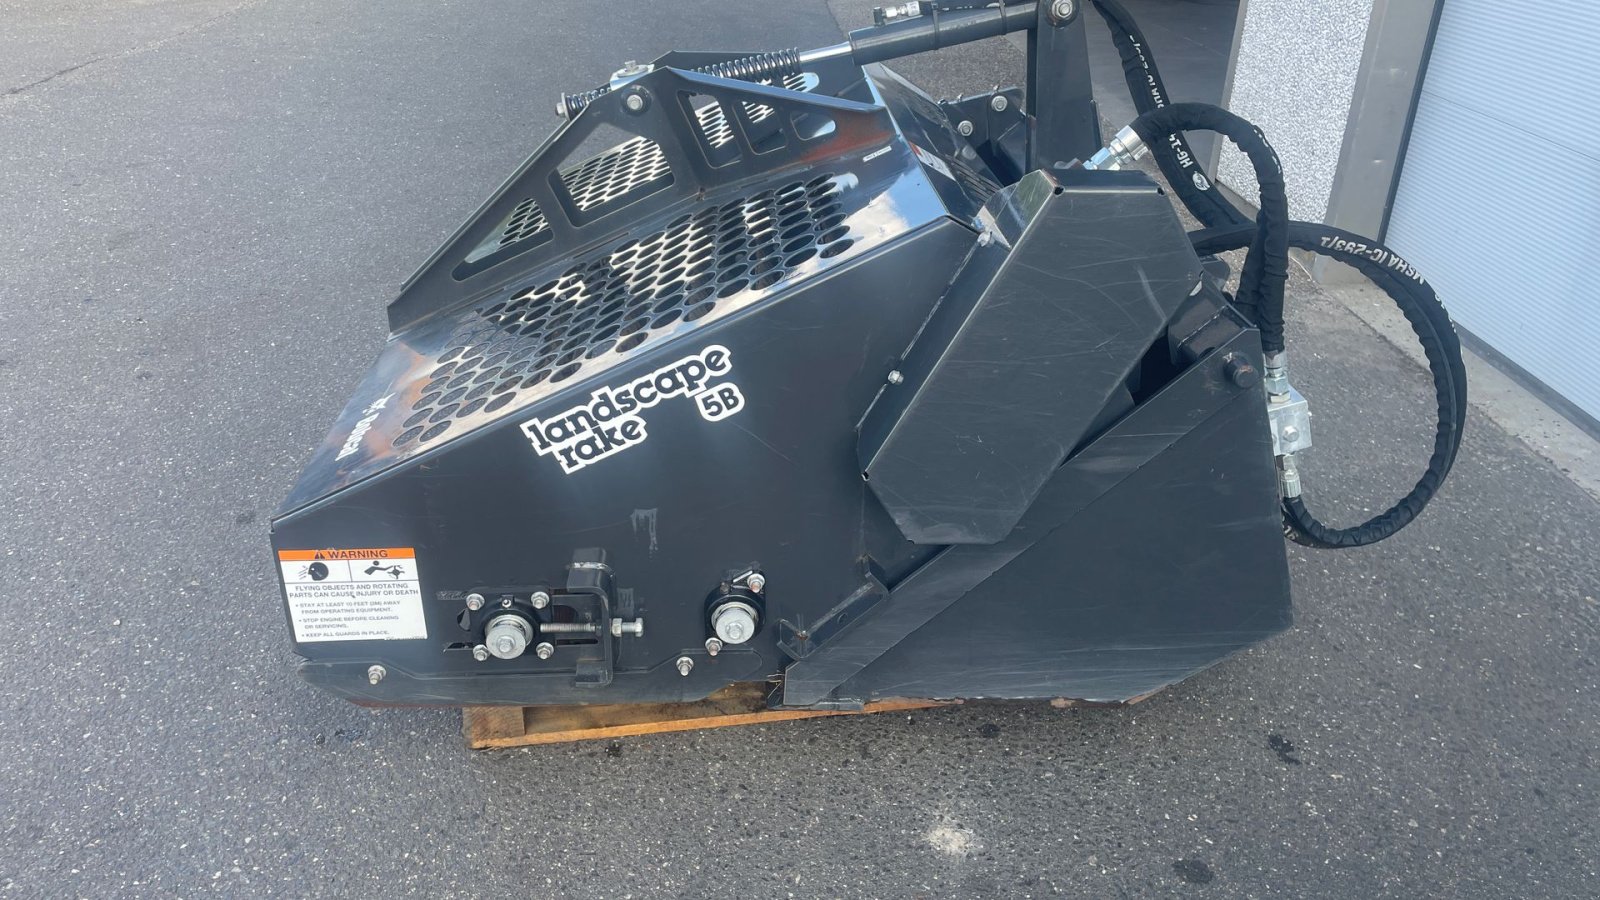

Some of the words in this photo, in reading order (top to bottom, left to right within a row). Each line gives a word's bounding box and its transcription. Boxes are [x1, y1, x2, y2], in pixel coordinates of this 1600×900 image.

[520, 345, 732, 456] landscape
[695, 382, 745, 422] 5B
[552, 415, 648, 475] rake
[328, 550, 388, 559] WARNING
